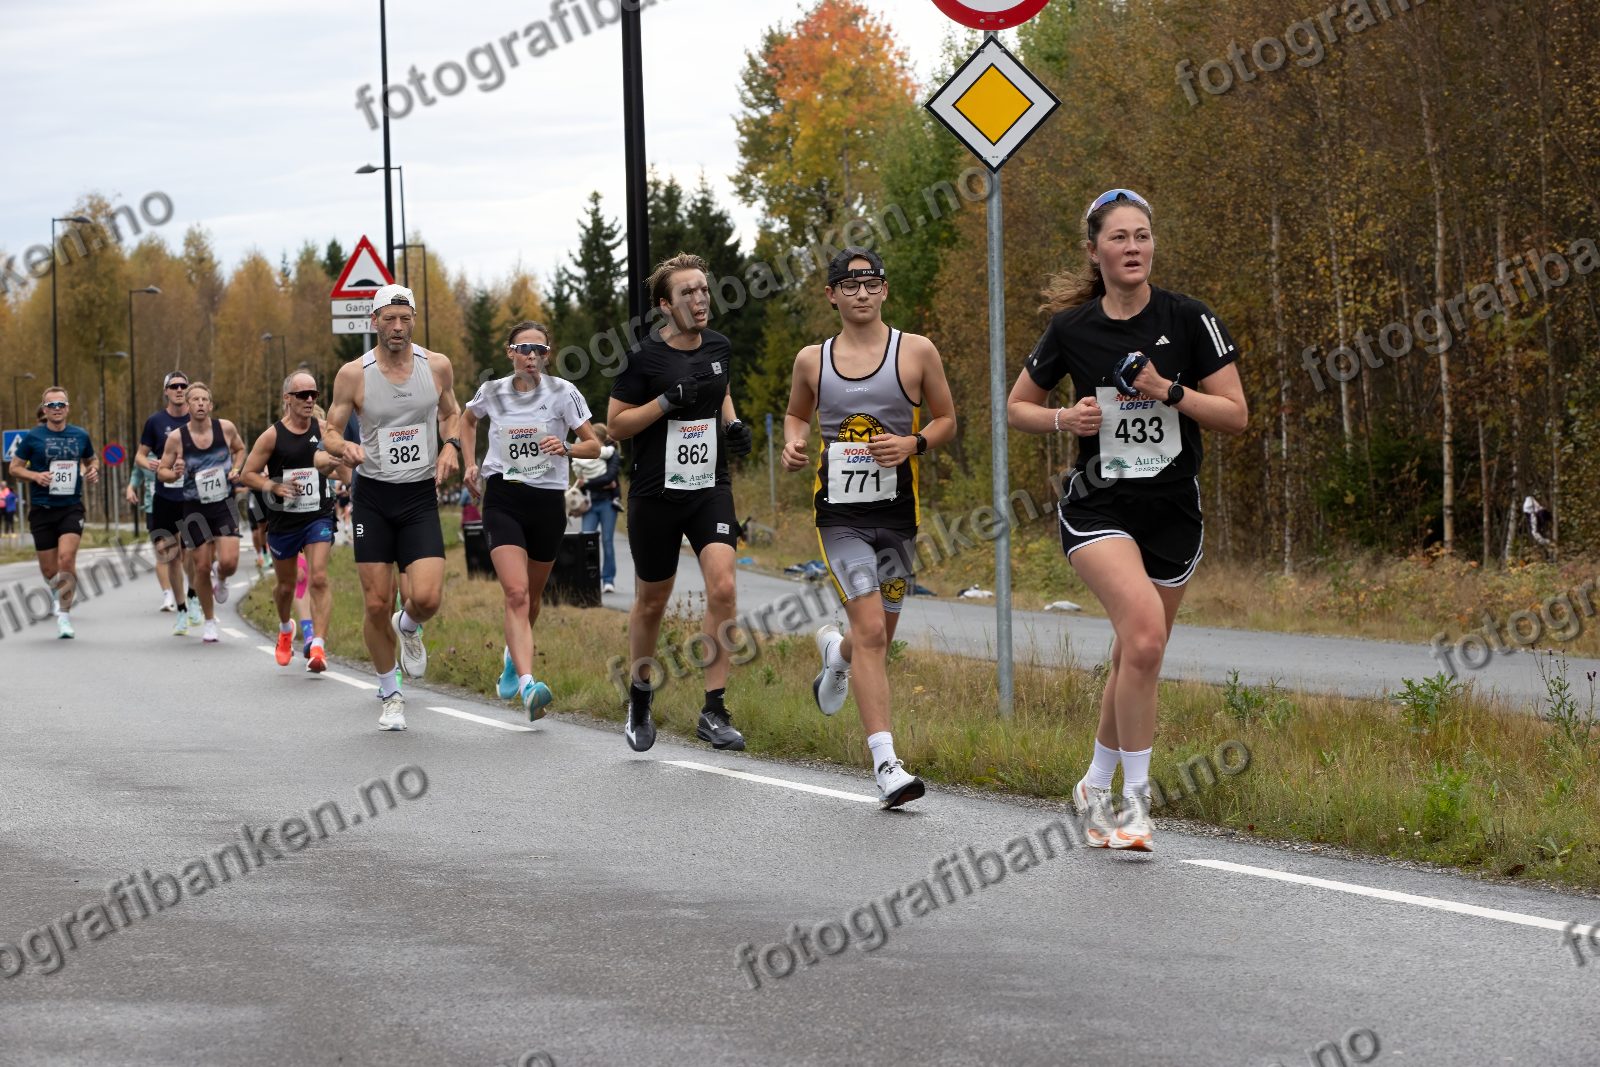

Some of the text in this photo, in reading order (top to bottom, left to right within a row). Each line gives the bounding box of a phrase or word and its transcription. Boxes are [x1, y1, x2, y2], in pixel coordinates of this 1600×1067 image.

[348, 321, 355, 330] 0
[1120, 400, 1156, 411] LØPET
[389, 428, 419, 437] NORGES
[679, 424, 709, 433] NORGES
[1115, 416, 1164, 444] 433
[392, 434, 415, 443] LØPET
[683, 431, 704, 439] LØPET
[389, 444, 421, 465] 382
[509, 441, 539, 460] 849
[677, 442, 709, 465] 862
[842, 448, 871, 456] NORG
[1135, 454, 1177, 466] Aursko
[55, 471, 72, 483] 361
[841, 469, 881, 494] 771
[202, 478, 221, 492] 774
